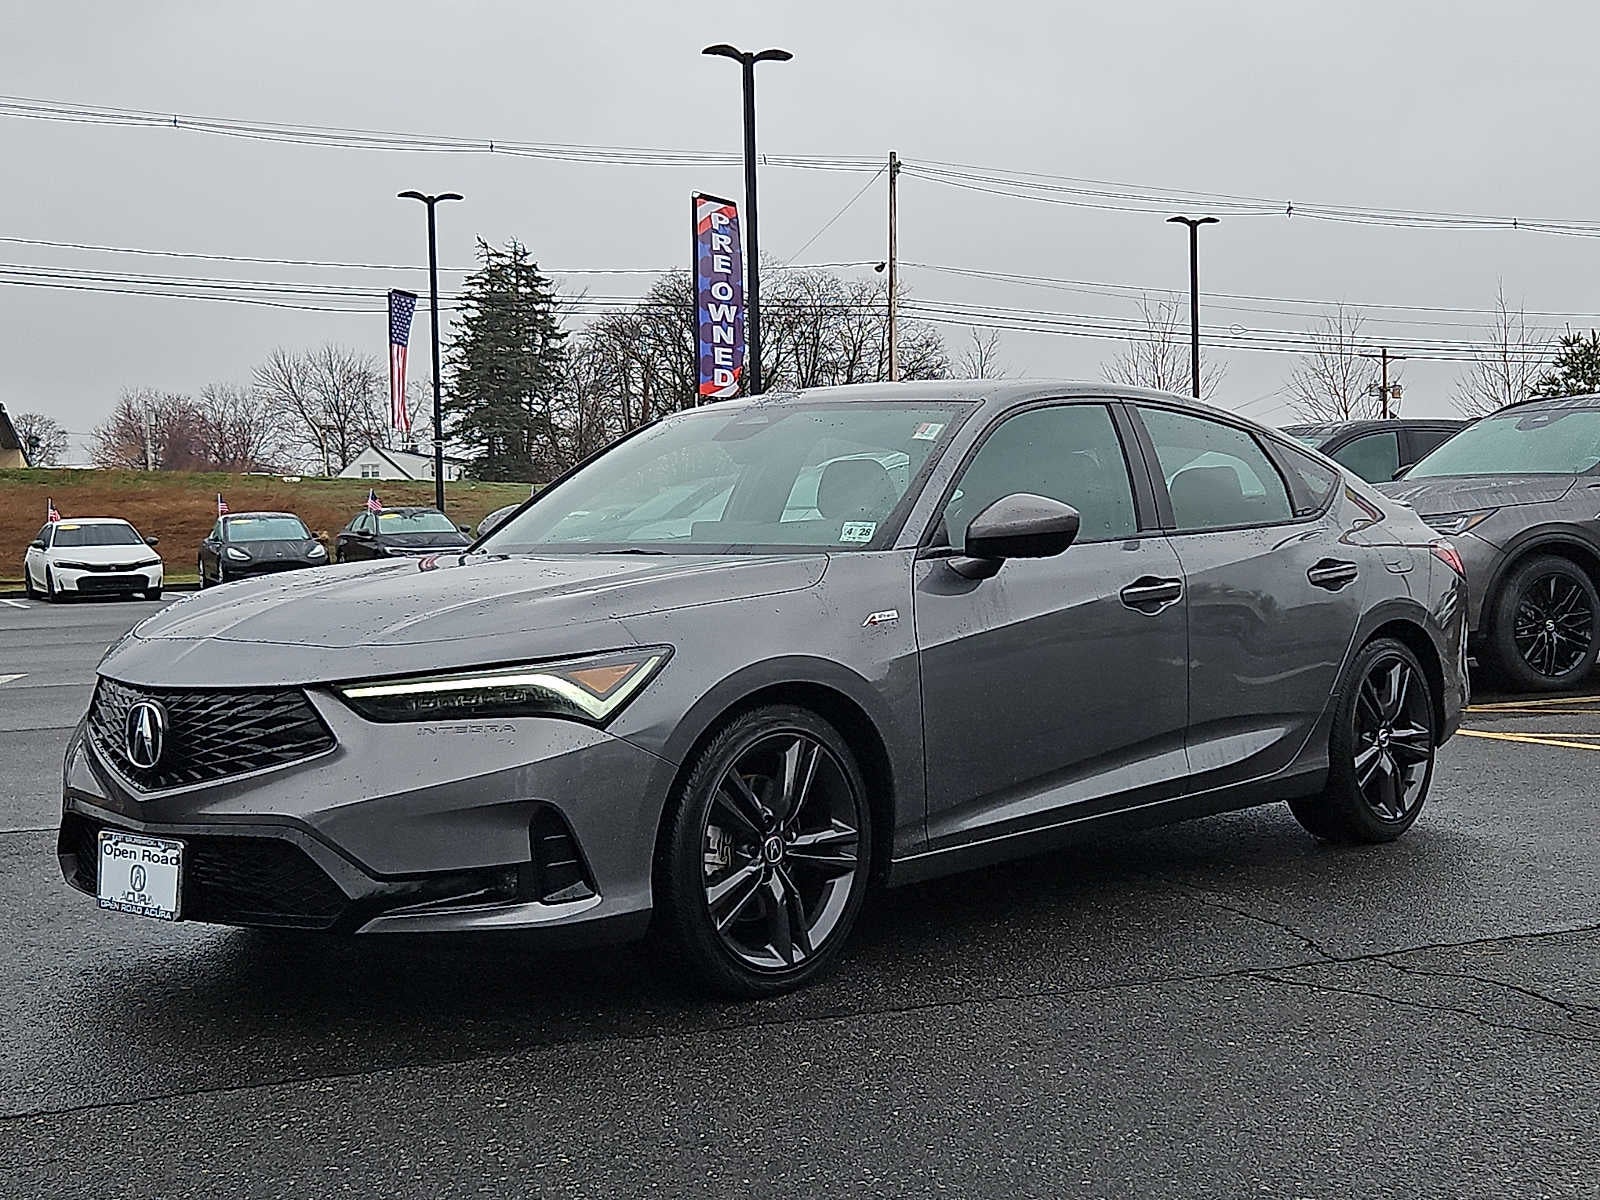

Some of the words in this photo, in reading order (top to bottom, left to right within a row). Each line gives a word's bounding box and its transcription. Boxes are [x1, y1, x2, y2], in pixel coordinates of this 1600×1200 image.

[710, 212, 732, 274] PRE
[708, 281, 737, 387] OWNED
[858, 528, 871, 536] 28
[416, 724, 516, 736] INTEGRA
[103, 843, 137, 860] Open
[141, 849, 180, 866] Road
[101, 901, 119, 910] OPEN
[121, 904, 142, 914] ROAD
[144, 908, 171, 919] ACURA
